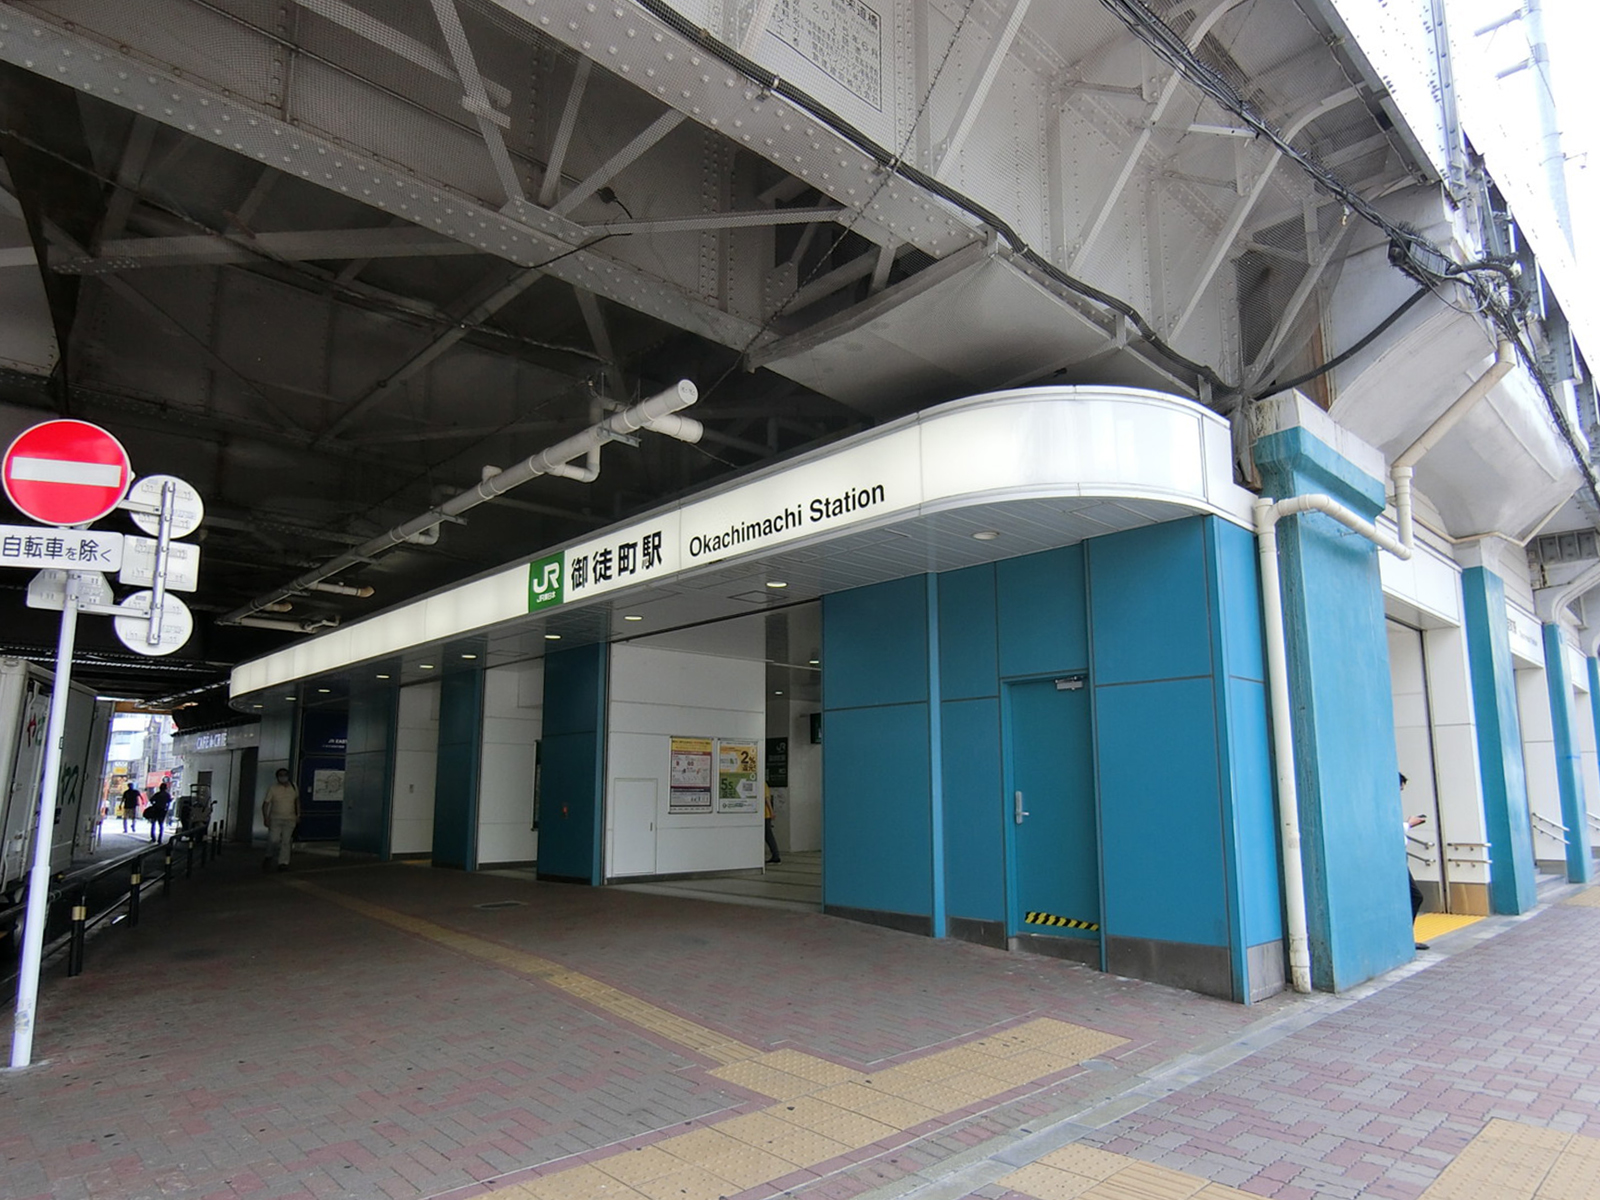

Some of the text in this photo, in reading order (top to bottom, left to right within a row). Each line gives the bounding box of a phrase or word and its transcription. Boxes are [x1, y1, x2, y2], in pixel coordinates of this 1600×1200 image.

[689, 484, 886, 557] Okachimachi Station
[2, 534, 112, 562] 自転車を除く
[571, 531, 662, 591] 御徒町駅
[533, 562, 560, 594] JR
